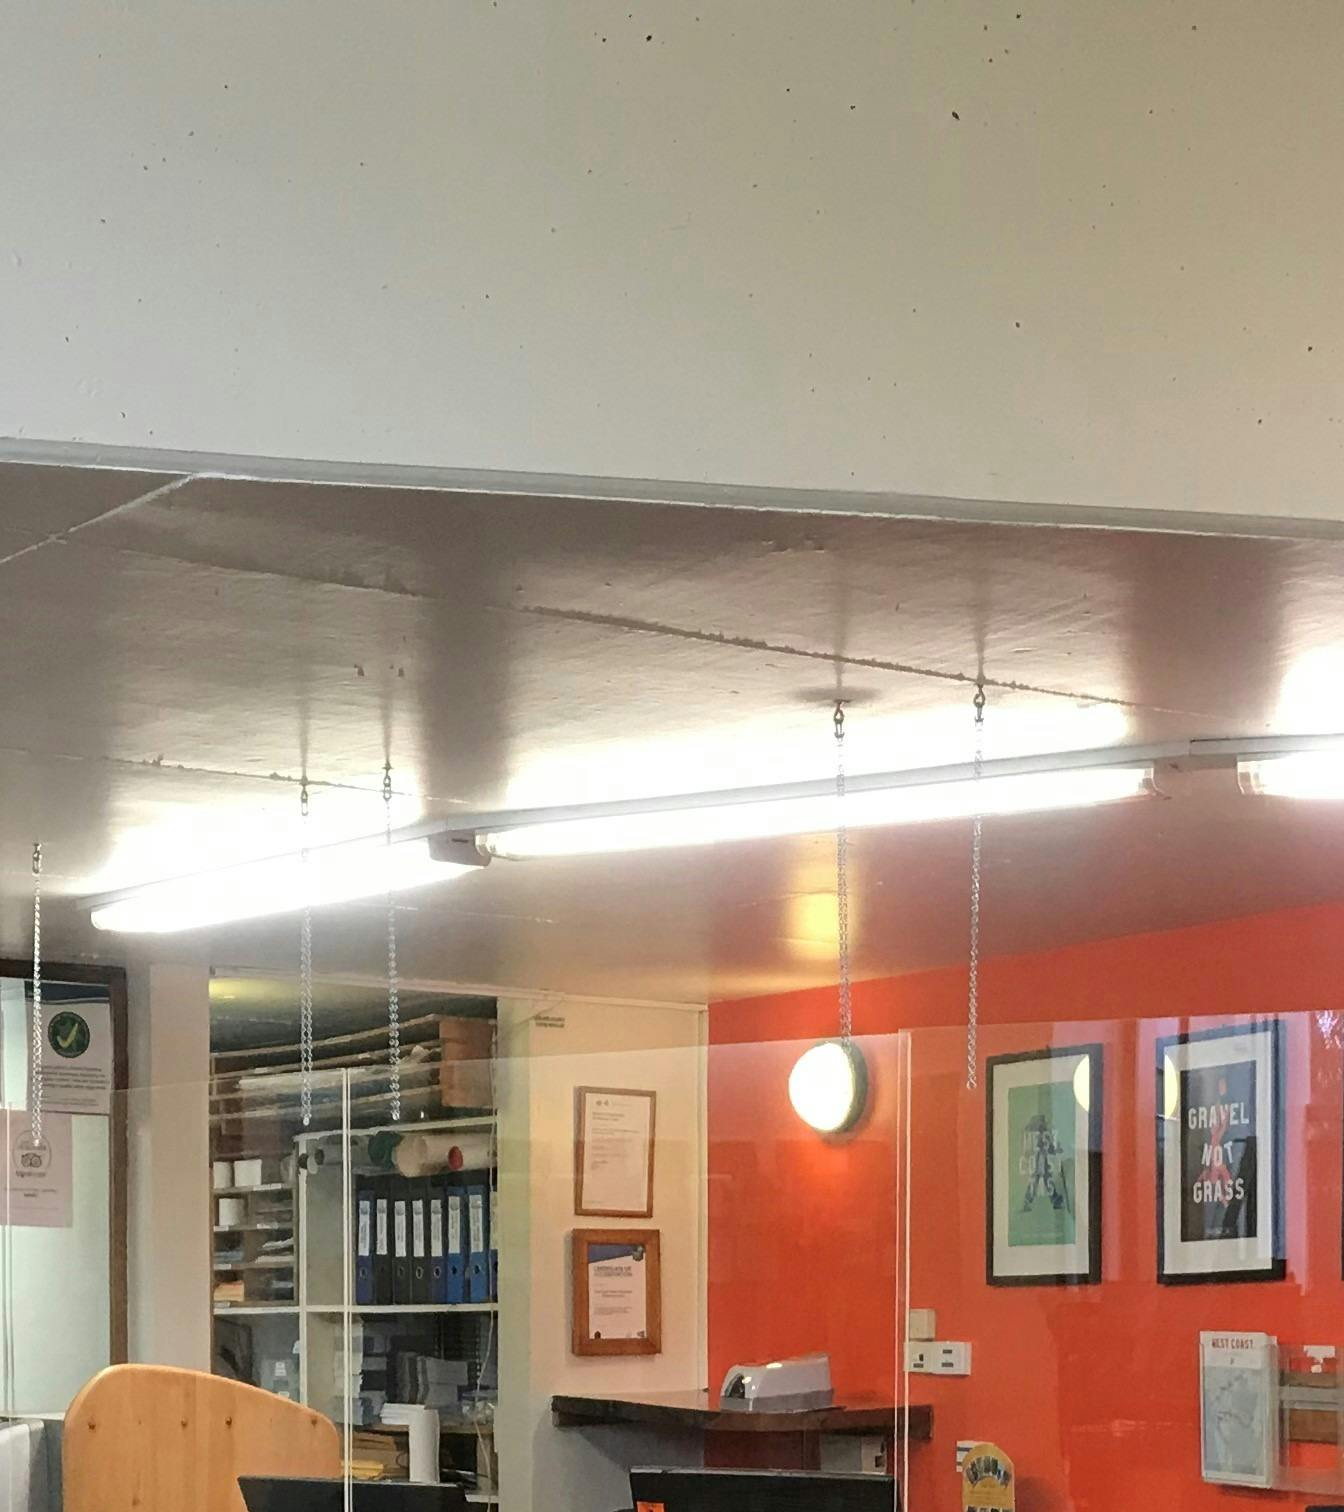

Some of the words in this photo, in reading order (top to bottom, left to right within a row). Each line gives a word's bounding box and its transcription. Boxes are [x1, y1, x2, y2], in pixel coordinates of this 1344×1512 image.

[1188, 1102, 1250, 1131] GRAVEL
[1201, 1141, 1233, 1167] NOT
[1193, 1177, 1245, 1204] GRASS
[1211, 1337, 1231, 1350] WEST
[1231, 1338, 1254, 1350] COAST
